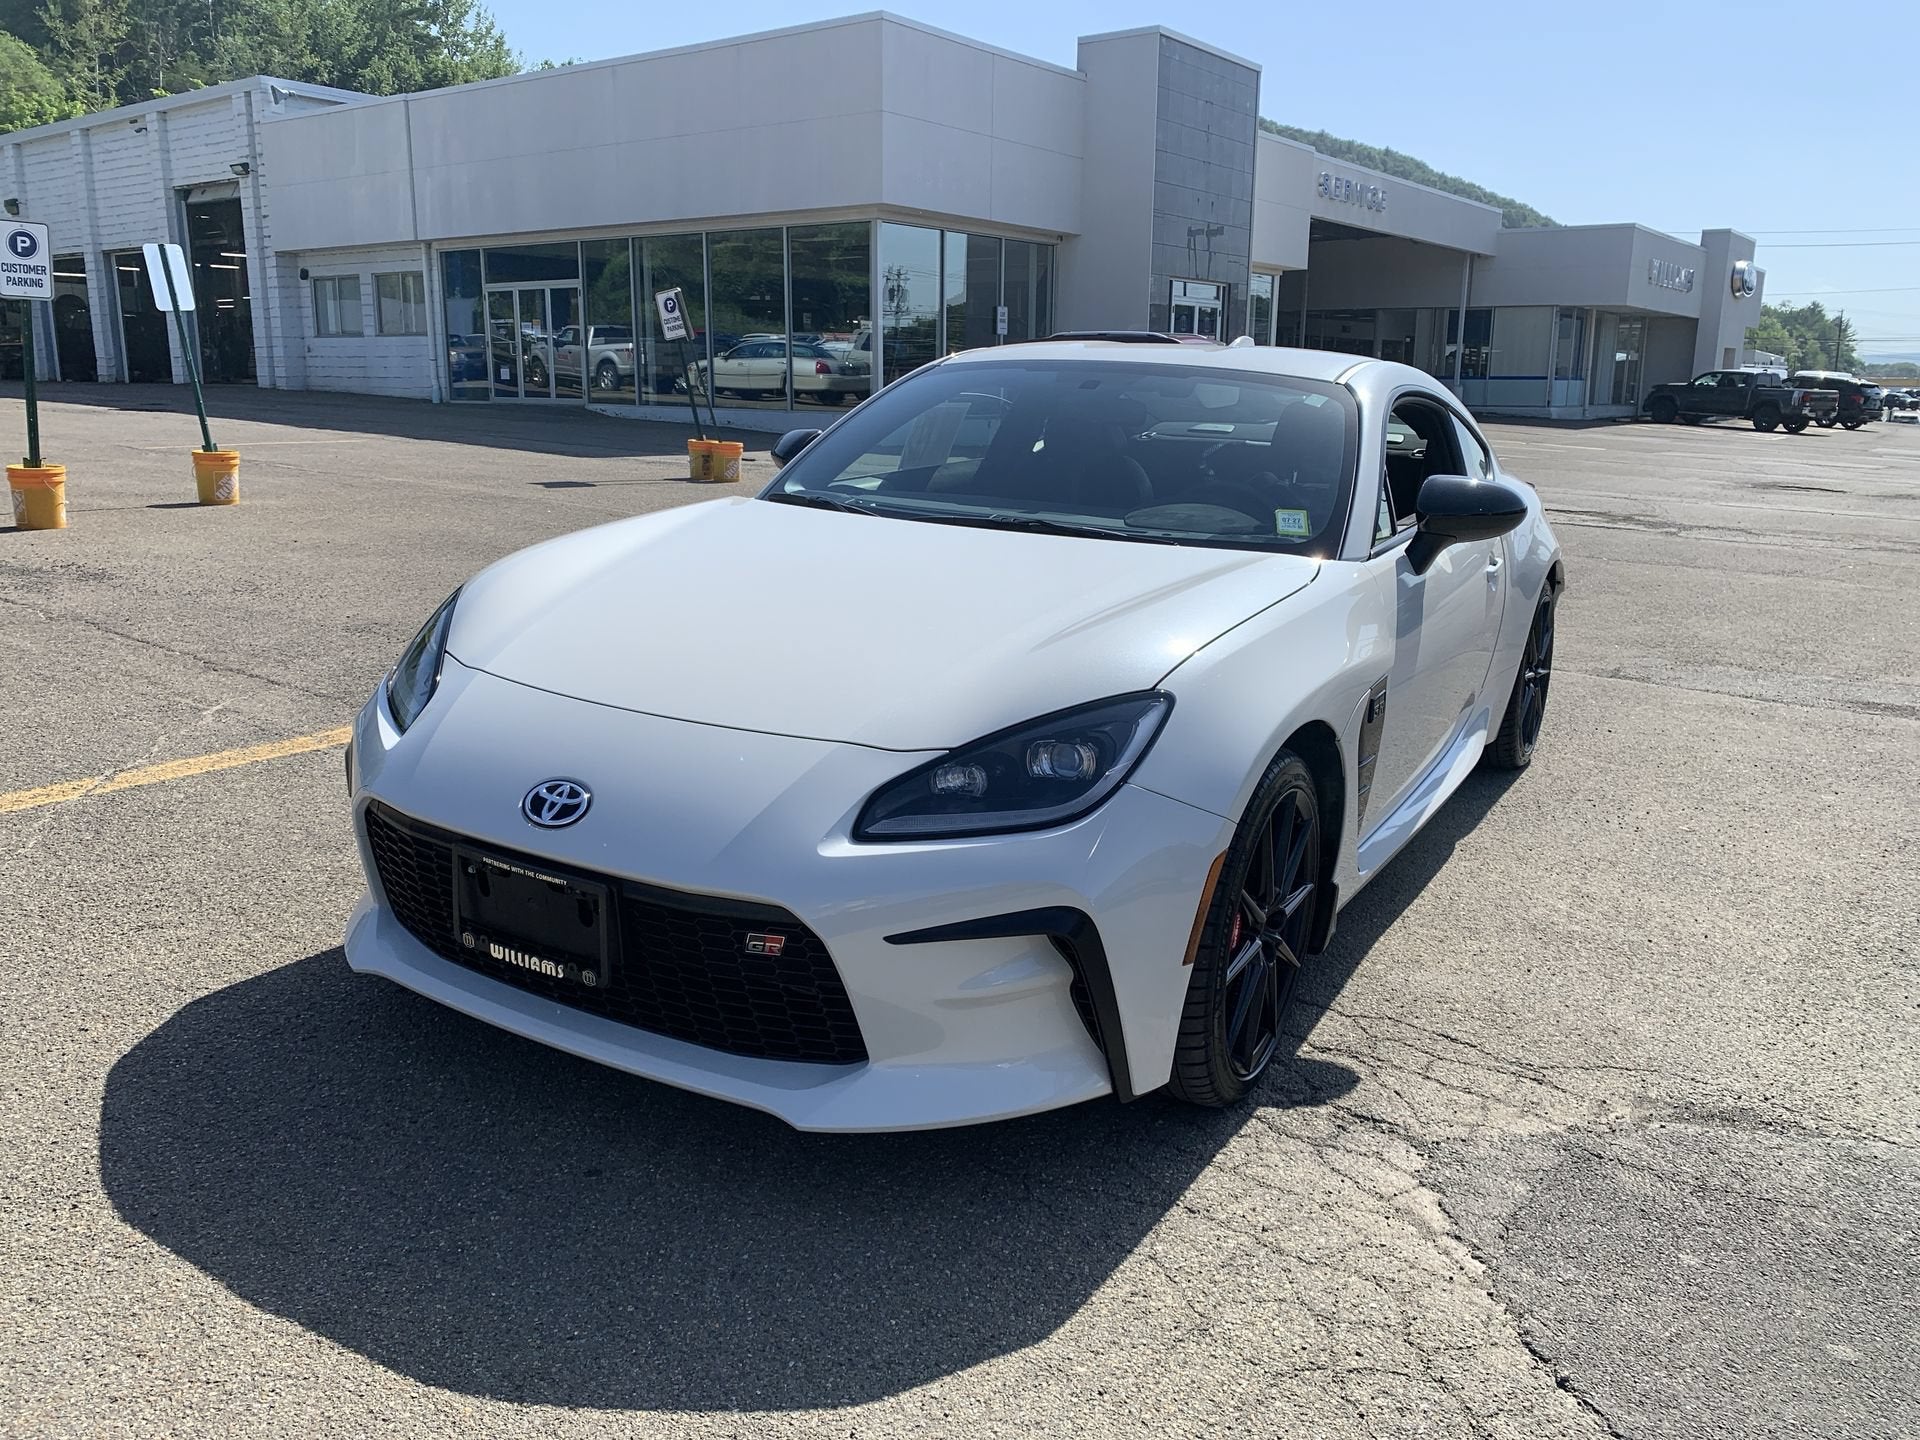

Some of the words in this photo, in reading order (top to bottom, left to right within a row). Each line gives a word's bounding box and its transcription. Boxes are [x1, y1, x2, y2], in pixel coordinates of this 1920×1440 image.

[1318, 171, 1387, 213] SERVICE
[16, 236, 30, 252] P
[1, 262, 47, 275] CUSTOMER
[6, 276, 43, 288] PARKING
[482, 857, 510, 870] PARTNERING
[511, 866, 524, 875] WITH
[524, 870, 535, 878] THE
[536, 873, 567, 885] COMMUNITY
[747, 941, 780, 953] GR
[490, 943, 564, 978] WILLIAMS
